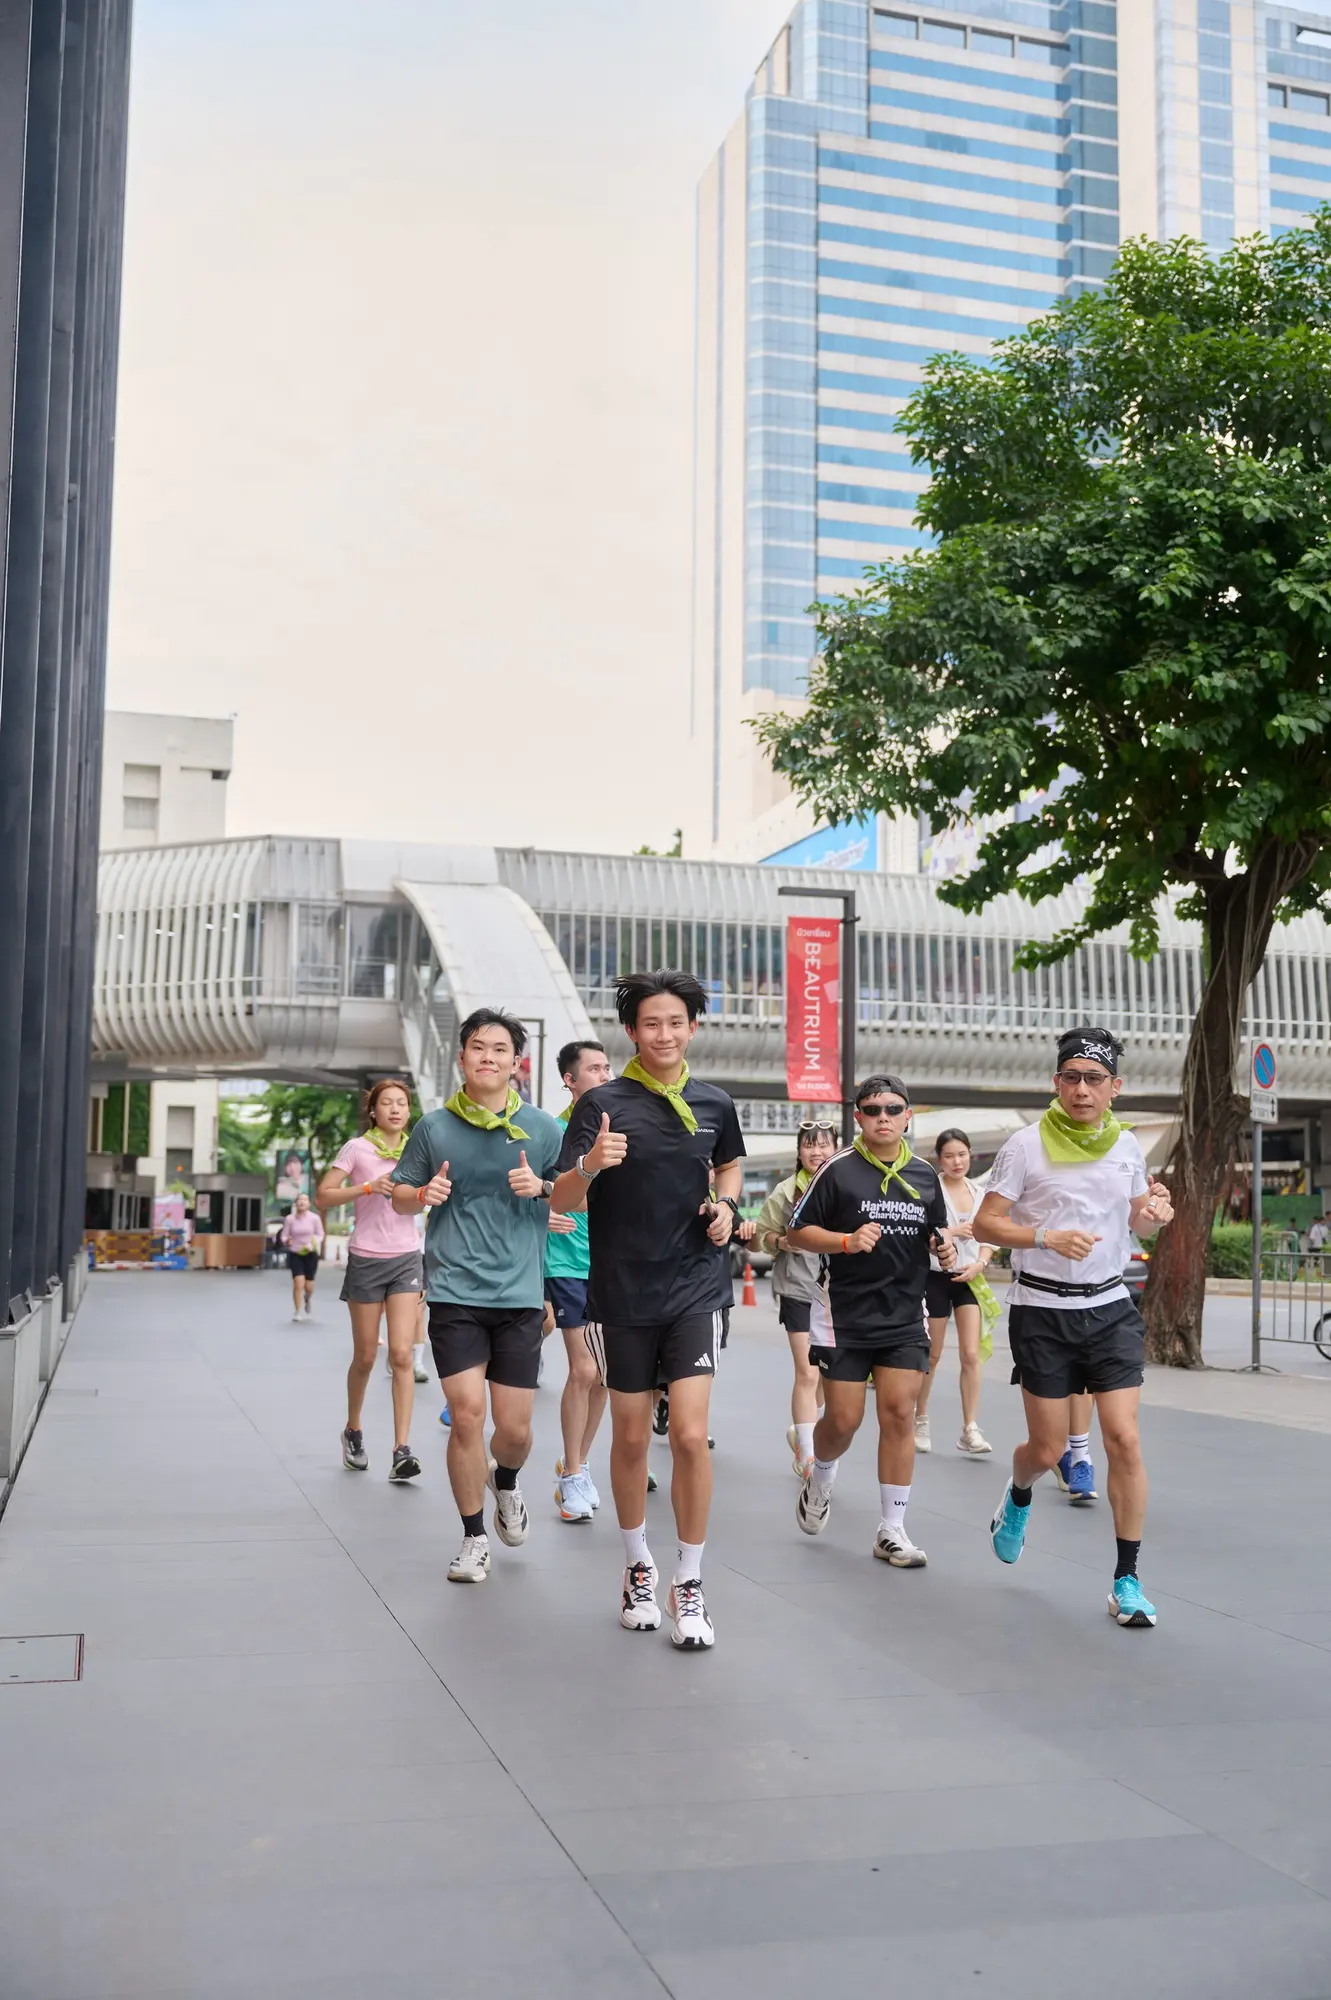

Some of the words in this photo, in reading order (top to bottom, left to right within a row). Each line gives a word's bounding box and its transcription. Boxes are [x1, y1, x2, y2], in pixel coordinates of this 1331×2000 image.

[803, 942, 821, 1071] BEAUTRIUM
[868, 1211, 900, 1221] Charity
[901, 1212, 917, 1221] Run
